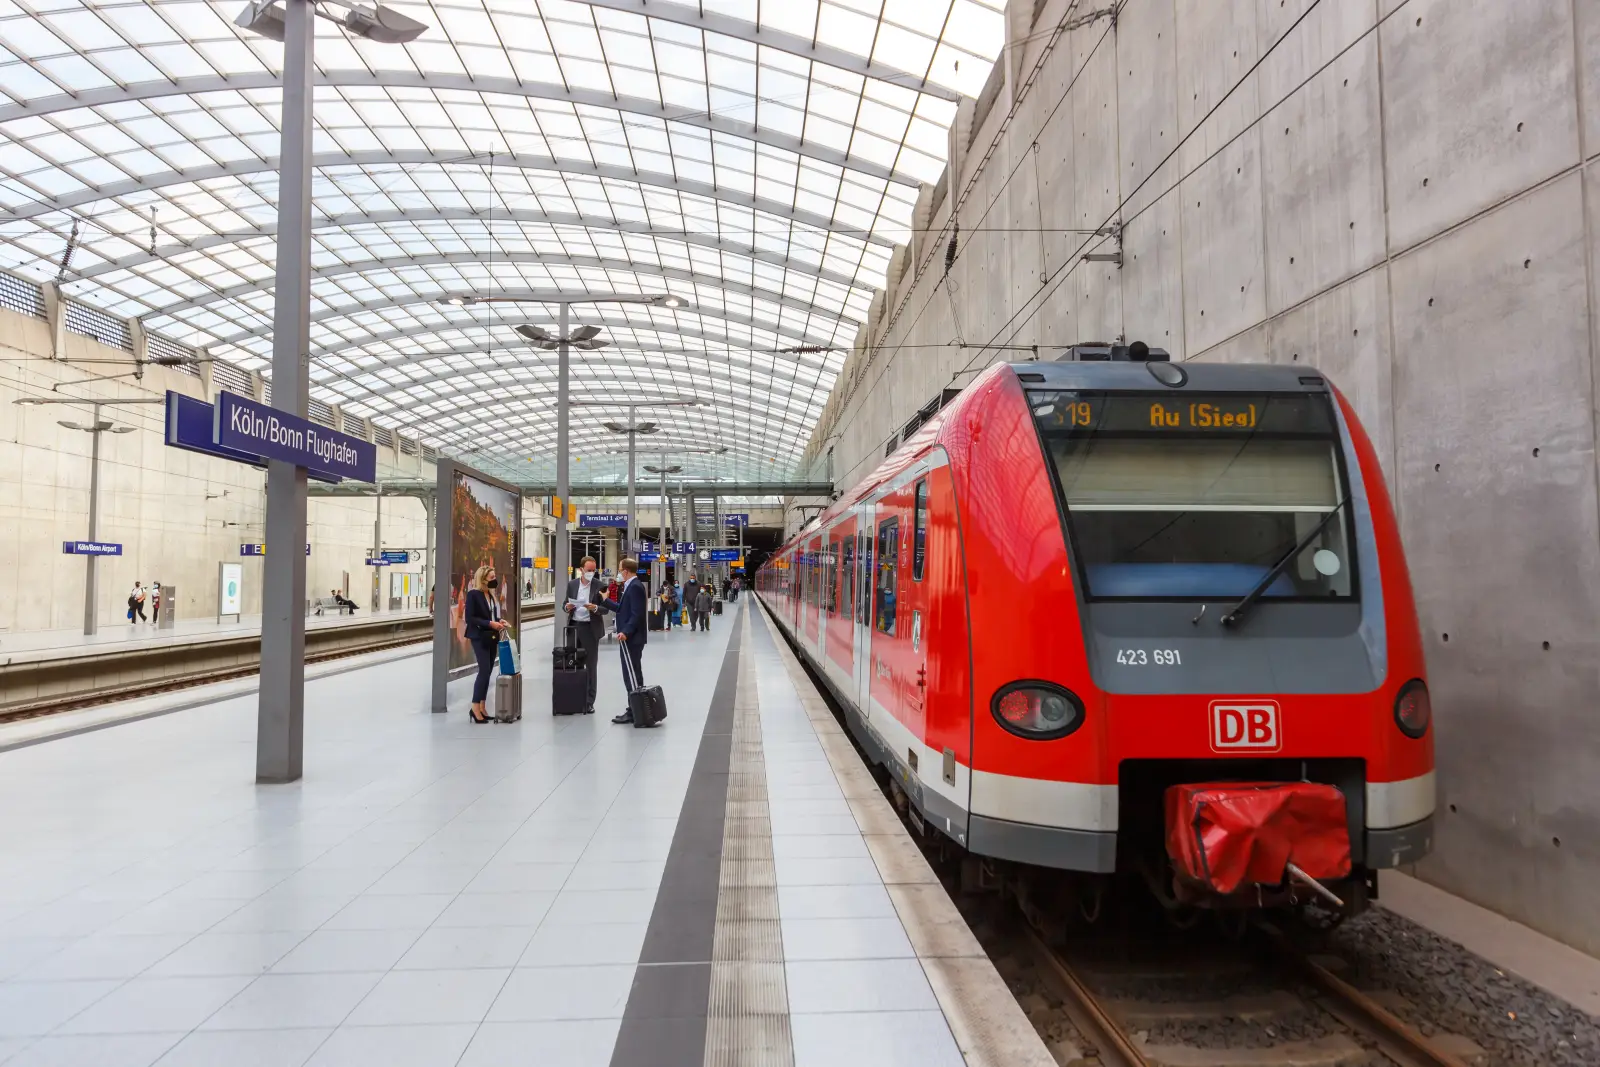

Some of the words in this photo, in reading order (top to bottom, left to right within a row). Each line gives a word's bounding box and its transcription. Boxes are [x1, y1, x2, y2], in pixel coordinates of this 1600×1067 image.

[1150, 403, 1180, 427] Au
[230, 404, 304, 451] Köln/Bonn
[306, 429, 358, 467] Flughafen
[102, 544, 117, 554] Airport
[241, 544, 247, 554] 1
[254, 544, 261, 554] E
[642, 542, 649, 552] E
[676, 542, 683, 552] E
[688, 542, 695, 552] 4
[1116, 649, 1148, 666] 423
[1153, 649, 1182, 666] 691
[1218, 708, 1273, 745] DB
